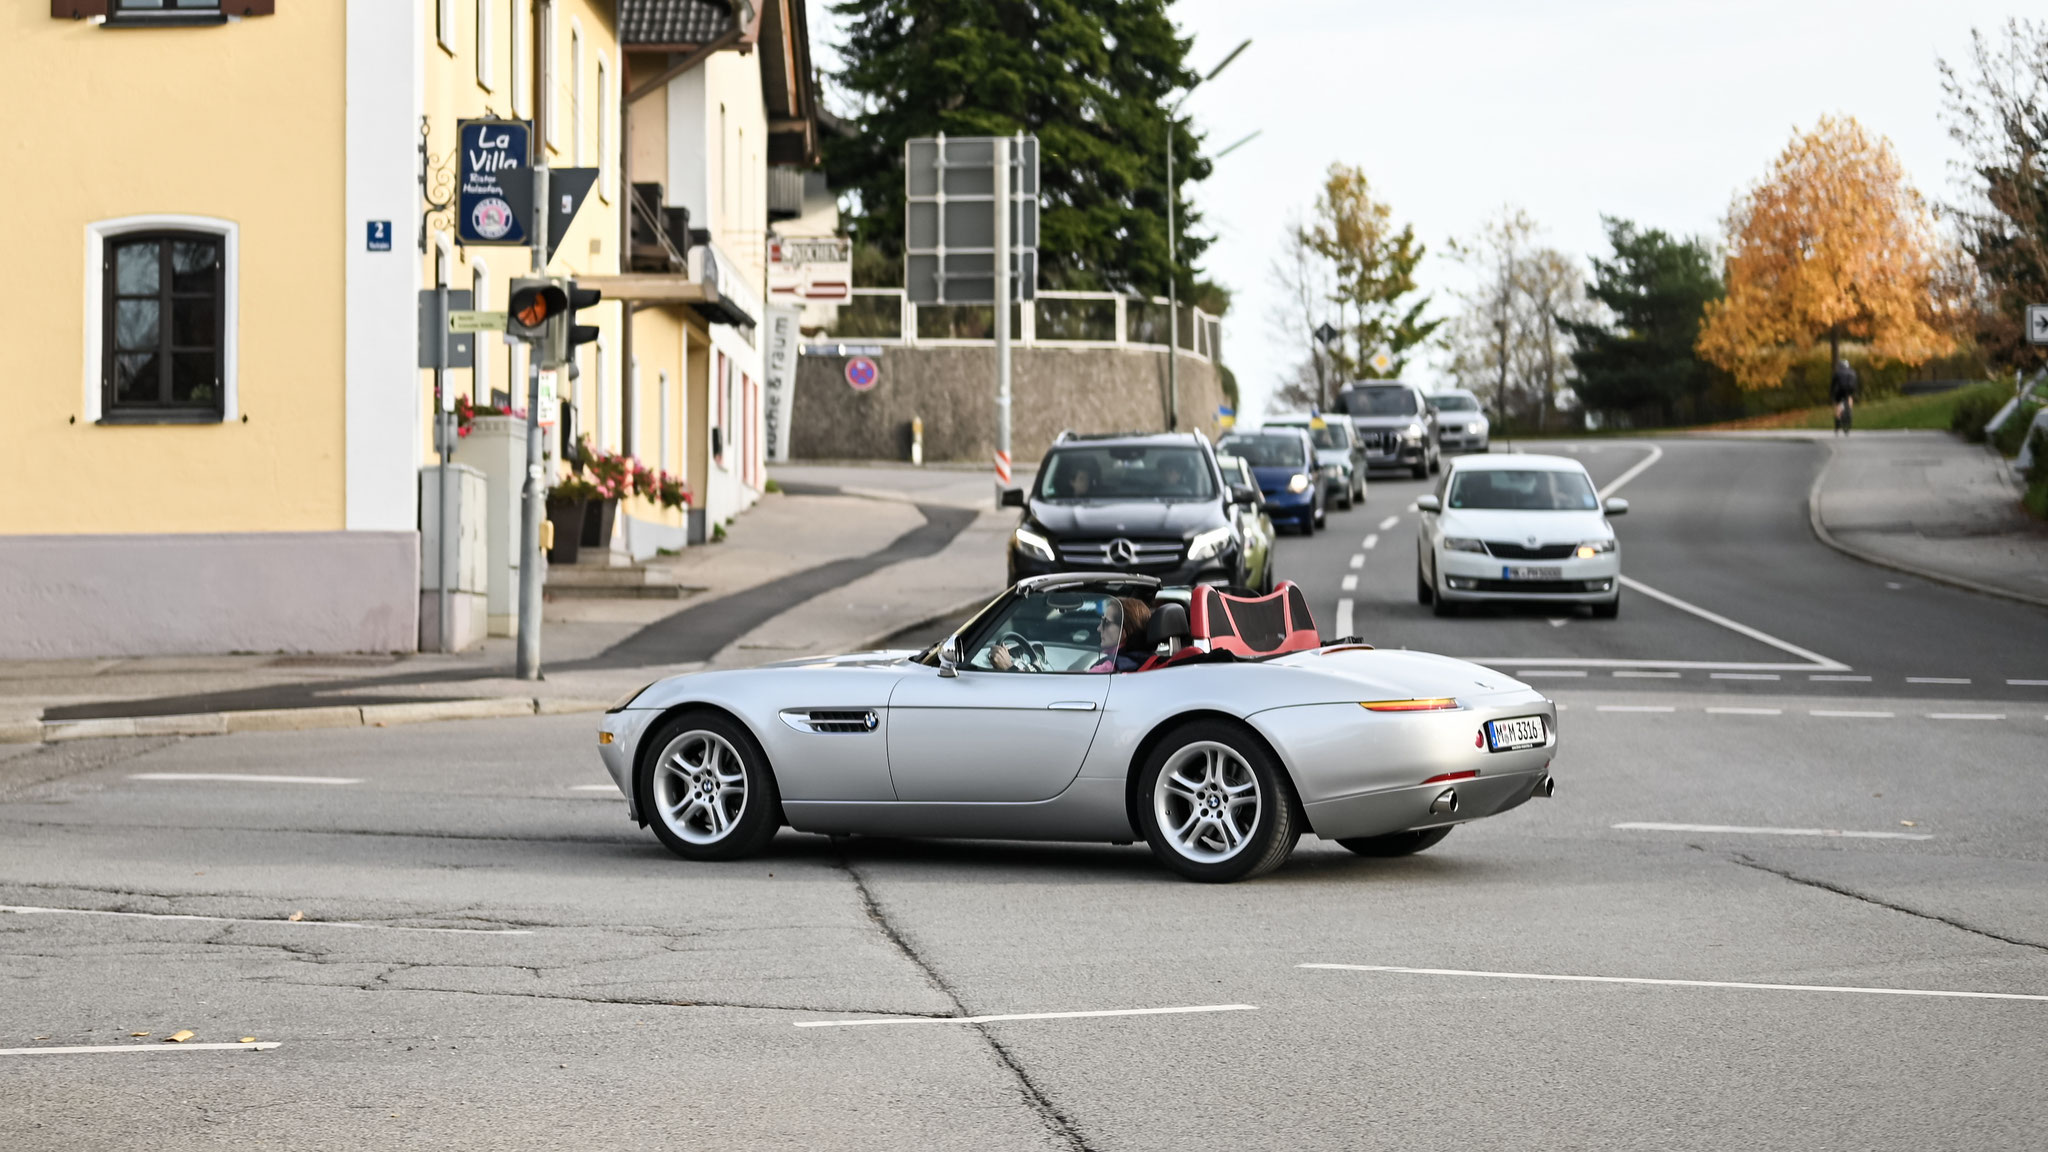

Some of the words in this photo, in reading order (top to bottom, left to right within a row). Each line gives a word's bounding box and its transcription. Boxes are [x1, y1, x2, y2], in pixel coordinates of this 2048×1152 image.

[478, 126, 510, 149] La
[469, 149, 518, 172] Villa
[375, 221, 384, 239] 2
[1516, 720, 1538, 741] 3316
